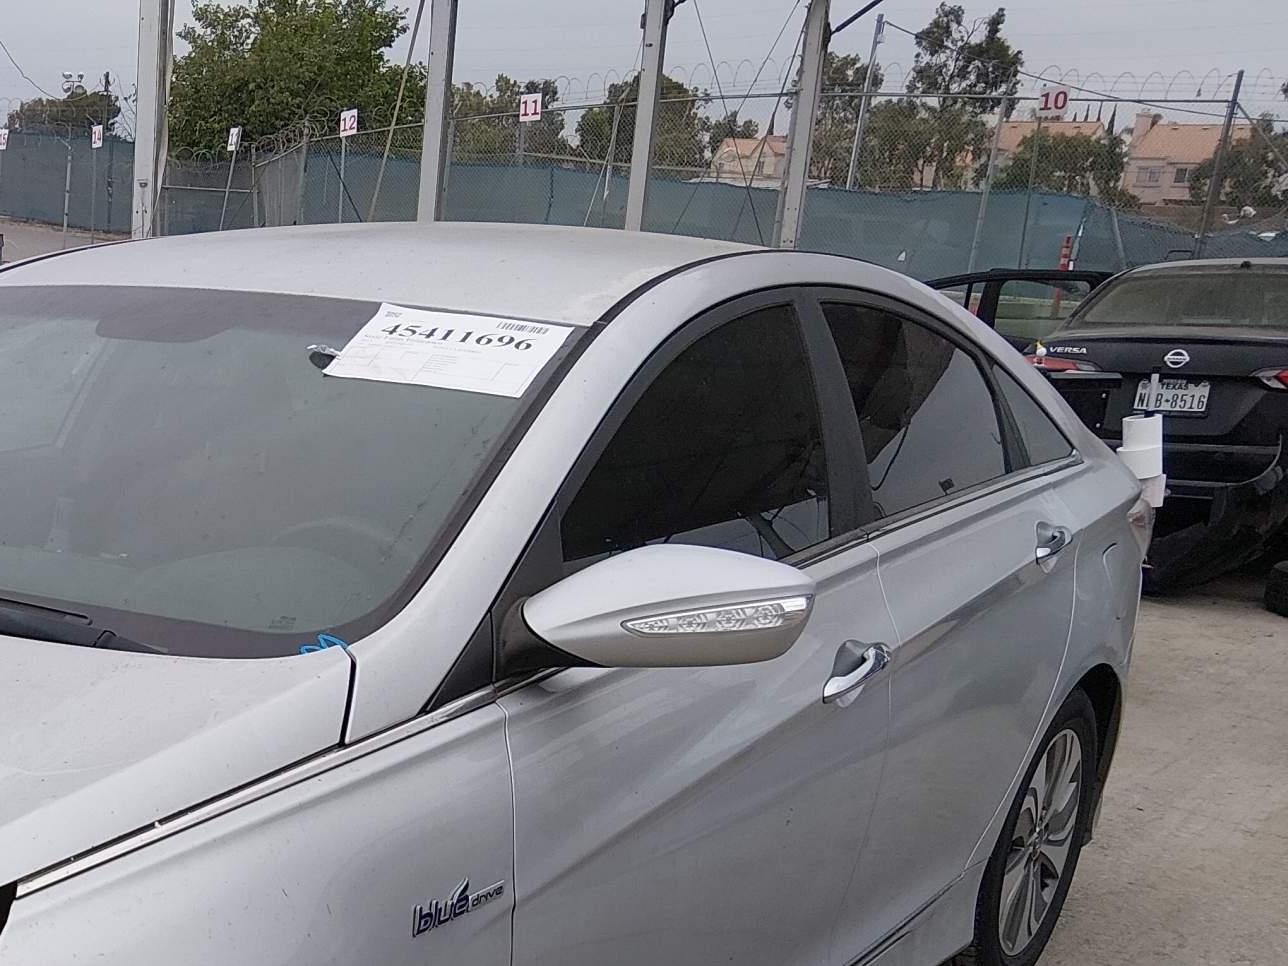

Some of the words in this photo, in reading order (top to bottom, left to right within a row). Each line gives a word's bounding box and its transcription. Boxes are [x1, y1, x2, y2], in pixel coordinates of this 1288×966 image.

[521, 98, 540, 117] 11
[1039, 90, 1068, 111] 10
[340, 114, 356, 132] 12
[92, 129, 102, 145] 14
[381, 323, 537, 351] 45411696
[1049, 346, 1088, 354] VERSA
[1160, 382, 1189, 391] TEXAS
[1136, 391, 1206, 410] NB-8516
[412, 879, 470, 938] blue
